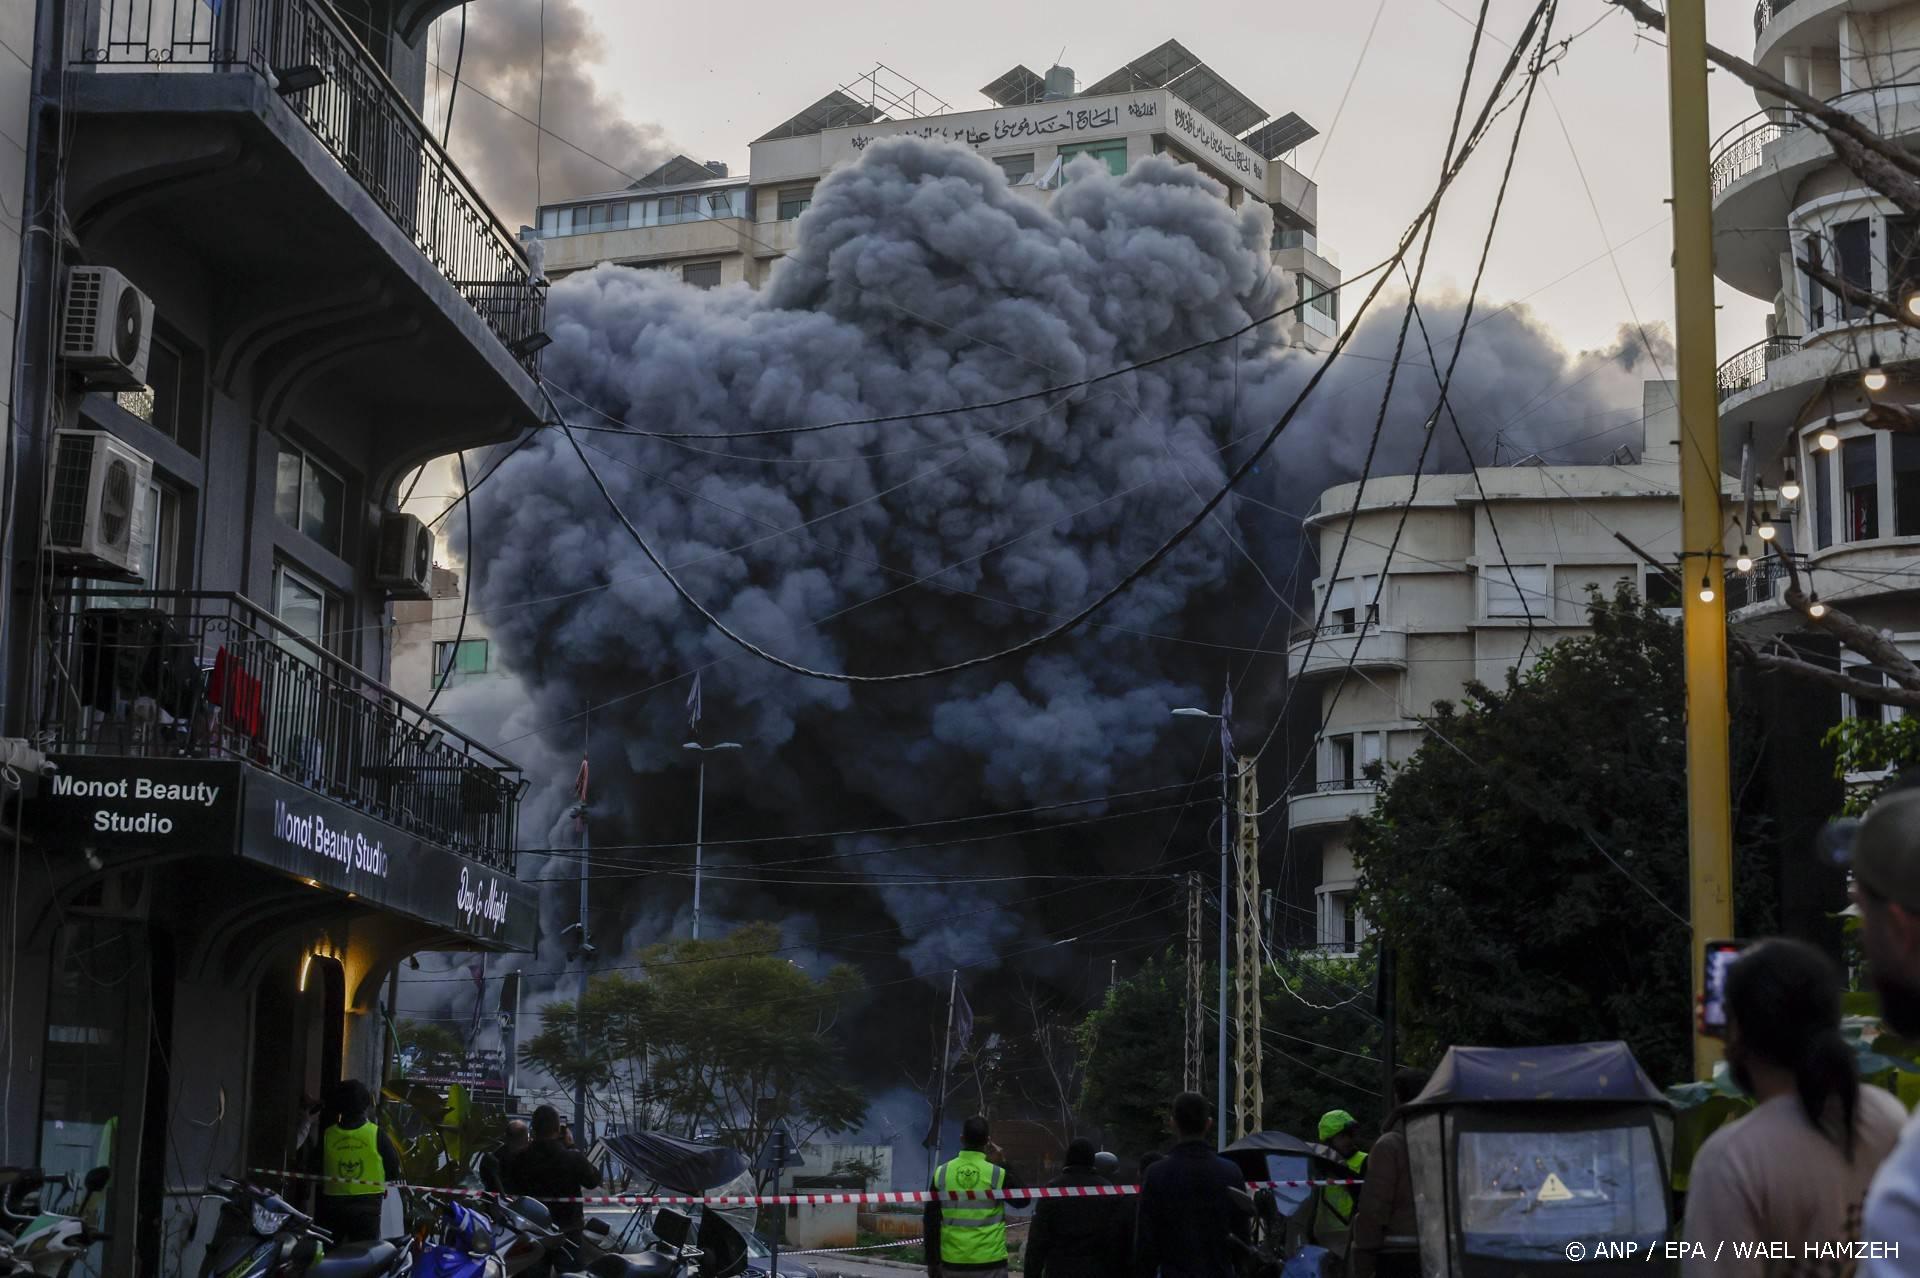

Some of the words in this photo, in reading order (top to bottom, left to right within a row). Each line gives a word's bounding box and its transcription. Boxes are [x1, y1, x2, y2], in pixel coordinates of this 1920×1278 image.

[1076, 106, 1119, 131] الحاج
[52, 775, 128, 798] Monot
[135, 778, 219, 807] Beauty
[94, 810, 173, 834] Studio
[274, 799, 312, 850] Monot
[315, 815, 354, 874] Beauty
[355, 832, 389, 878] Studio
[457, 866, 475, 926] Day
[475, 880, 484, 916] &
[483, 877, 509, 934] Night
